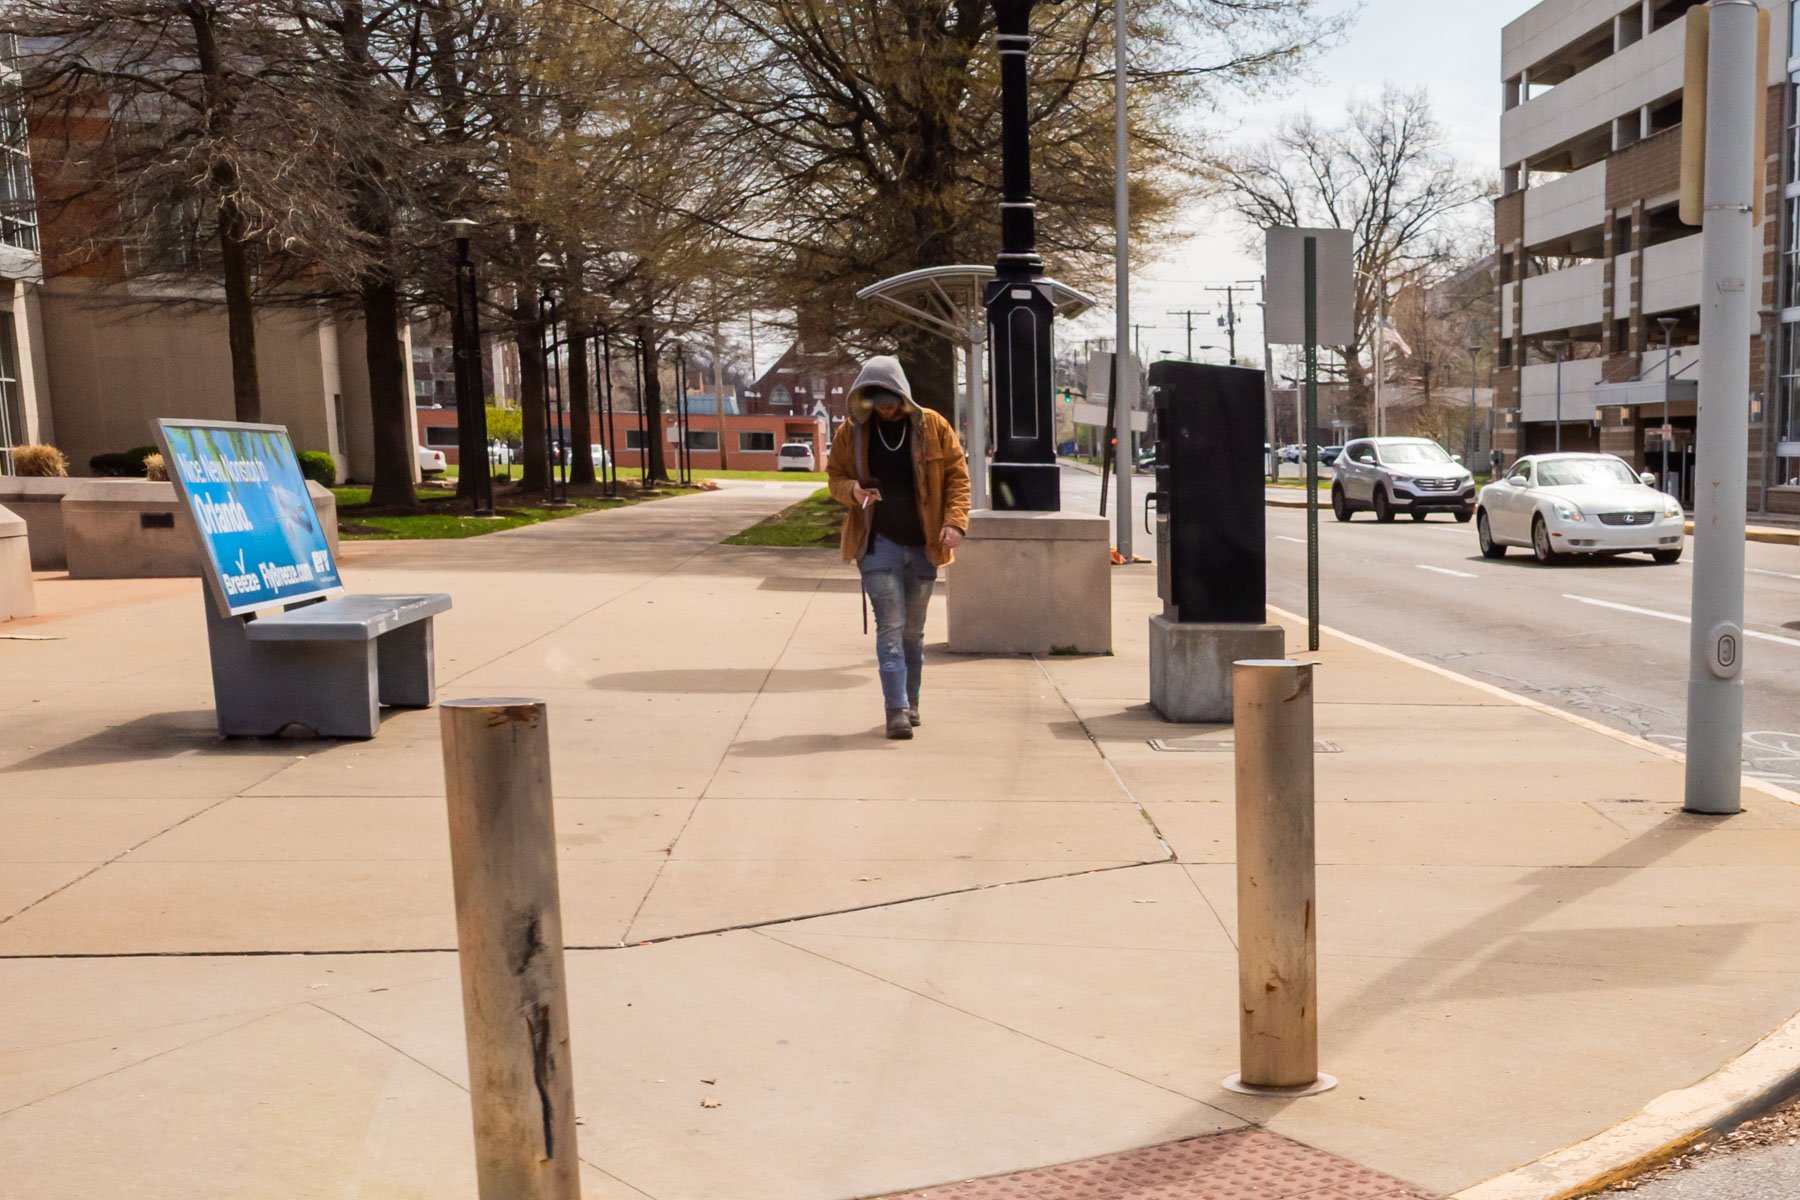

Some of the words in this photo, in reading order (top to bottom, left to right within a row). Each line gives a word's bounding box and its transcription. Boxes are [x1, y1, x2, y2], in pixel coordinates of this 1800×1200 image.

[219, 453, 262, 489] Nonstop
[253, 457, 269, 483] to
[194, 491, 254, 534] Orlando.
[222, 573, 261, 595] Breeze
[258, 562, 314, 595] FlyBreeze.com
